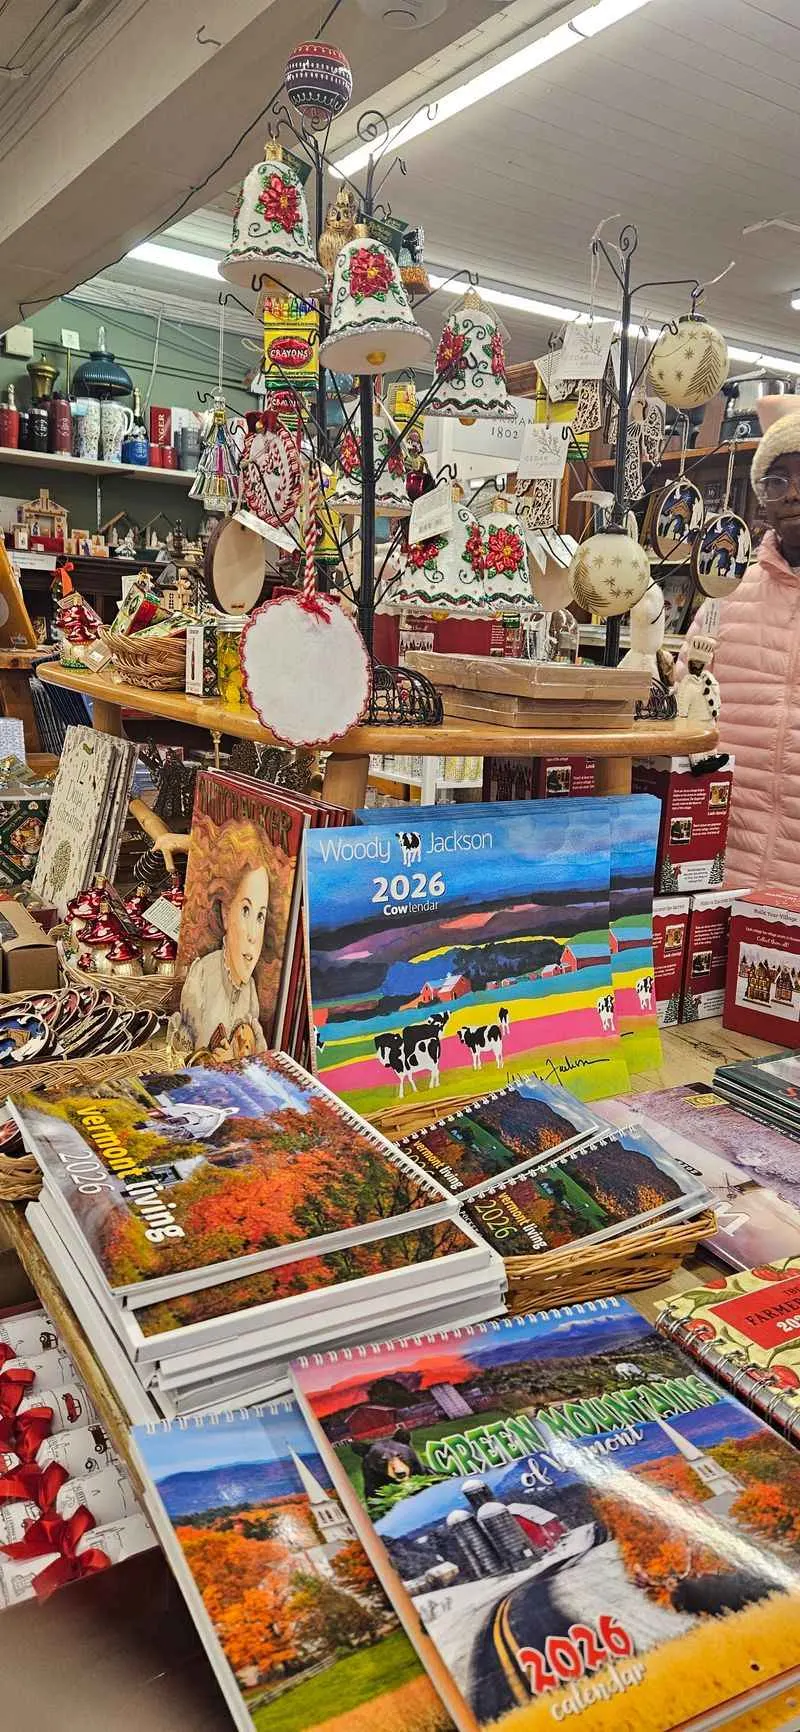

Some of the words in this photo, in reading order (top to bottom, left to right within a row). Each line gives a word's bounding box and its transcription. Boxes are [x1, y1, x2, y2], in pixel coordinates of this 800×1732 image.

[270, 348, 309, 359] CRAYONS
[490, 427, 519, 440] 1802
[319, 835, 391, 864] Woody
[426, 830, 493, 854] Jackson
[371, 871, 446, 903] 2026
[383, 901, 439, 916] Cowlendar
[59, 1150, 115, 1194] 2026
[77, 1105, 152, 1179] vermont
[124, 1179, 186, 1243] living
[413, 1140, 445, 1169] vermont
[440, 1166, 464, 1190] living
[474, 1199, 518, 1239] 2026
[498, 1192, 529, 1226] vermont
[522, 1223, 548, 1250] living
[425, 1414, 549, 1477] GREEN
[536, 1374, 721, 1442] MOUNTAINS
[520, 1458, 554, 1488] of
[516, 1612, 634, 1695] 2026
[551, 1657, 647, 1722] calendar
